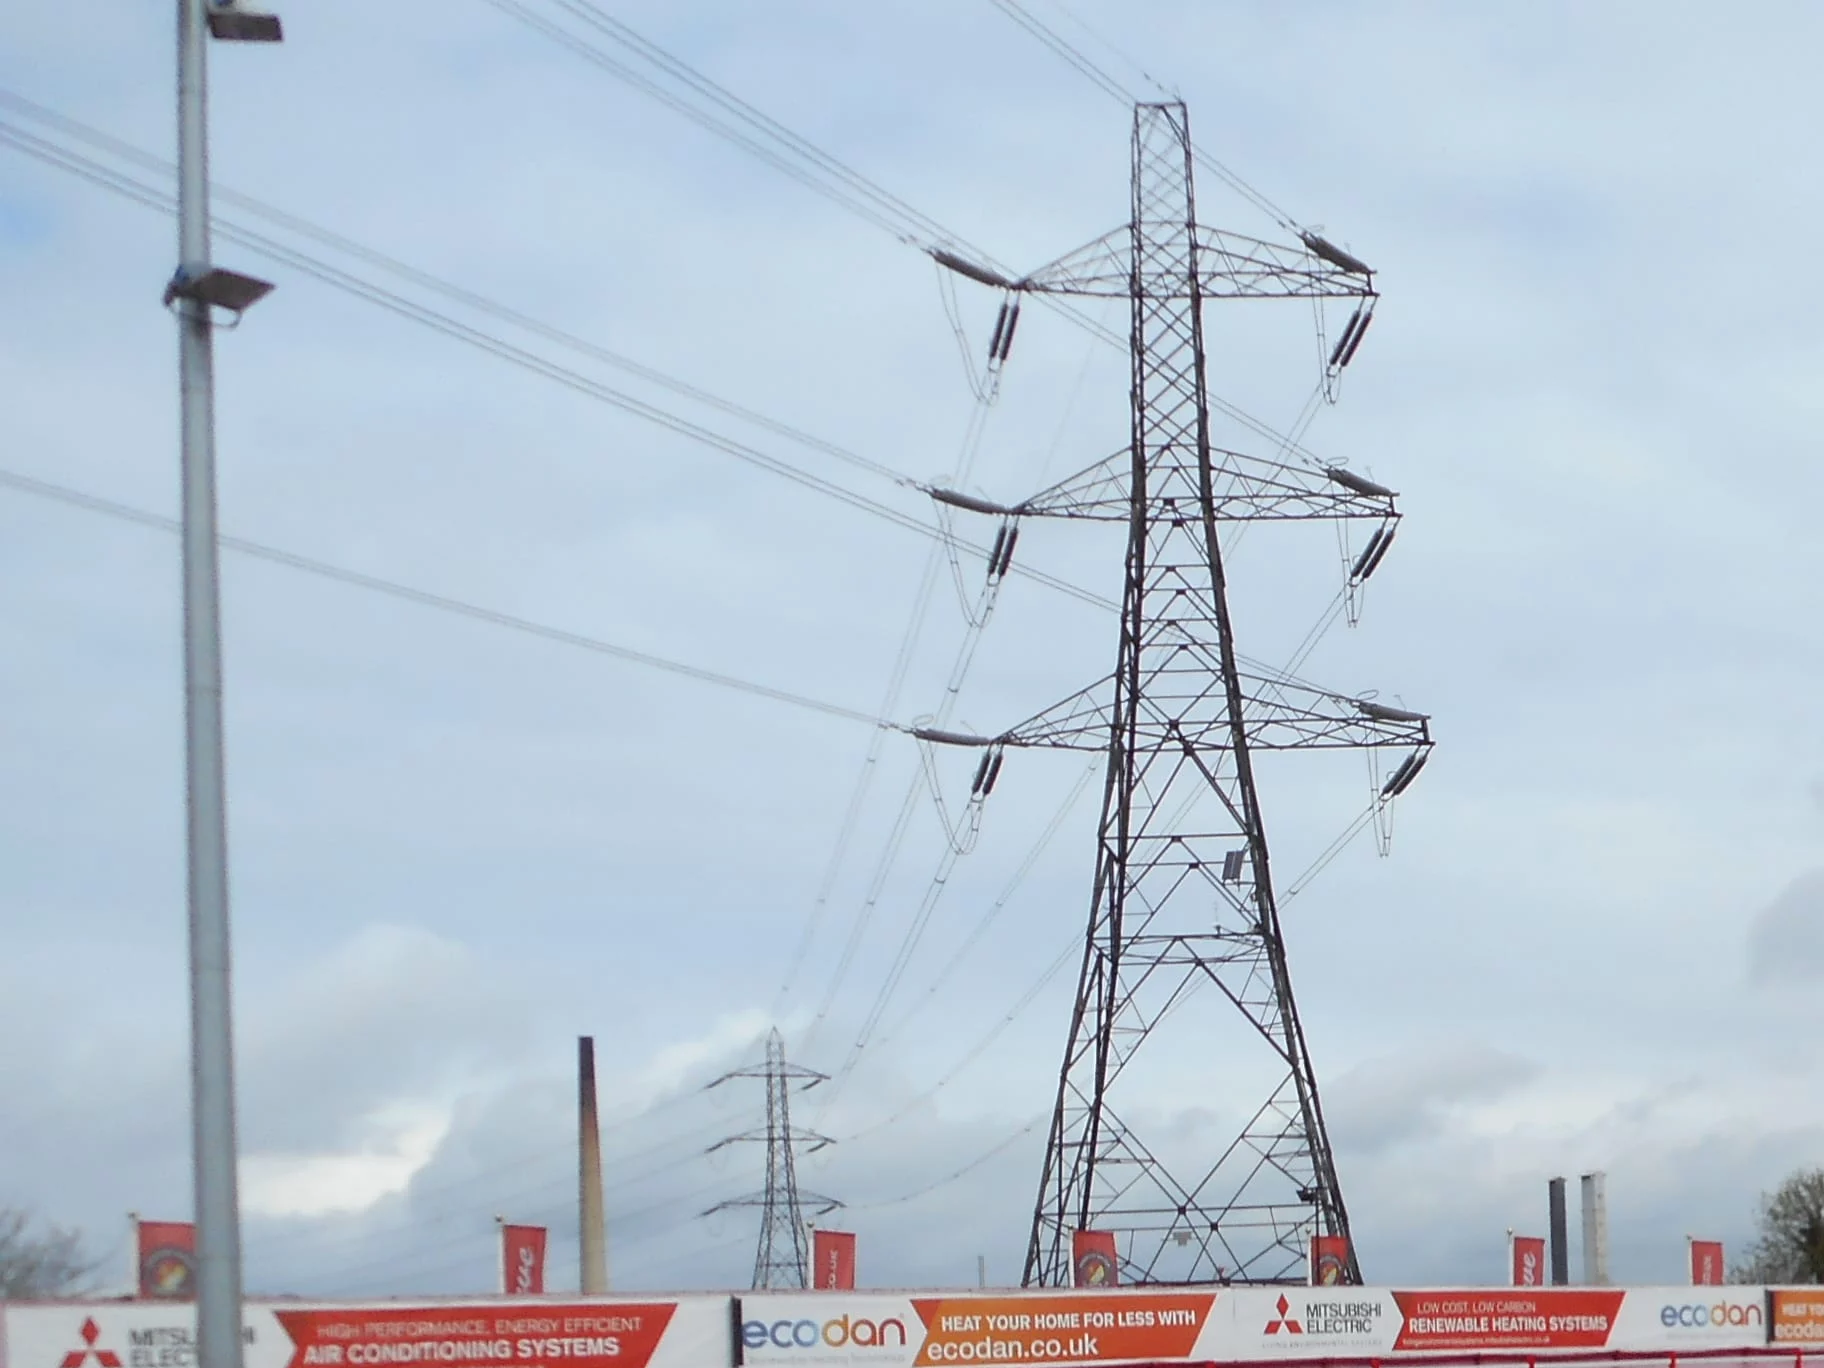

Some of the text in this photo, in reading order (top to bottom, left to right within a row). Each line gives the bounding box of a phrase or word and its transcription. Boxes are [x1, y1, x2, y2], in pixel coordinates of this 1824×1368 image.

[942, 1310, 1195, 1332] HEAT YOUR HOME FOR LESS WITH
[1306, 1303, 1381, 1318] MITSUBISHI
[1660, 1300, 1762, 1327] ecodan
[743, 1313, 906, 1348] ecodan
[1307, 1319, 1372, 1333] ELECTRIC
[1409, 1315, 1608, 1333] RENEWABLE HEATING SYSTEMS
[304, 1337, 619, 1365] AIR CONDITIONING SYSTEMS
[927, 1333, 1098, 1361] ecodan.co.uk
